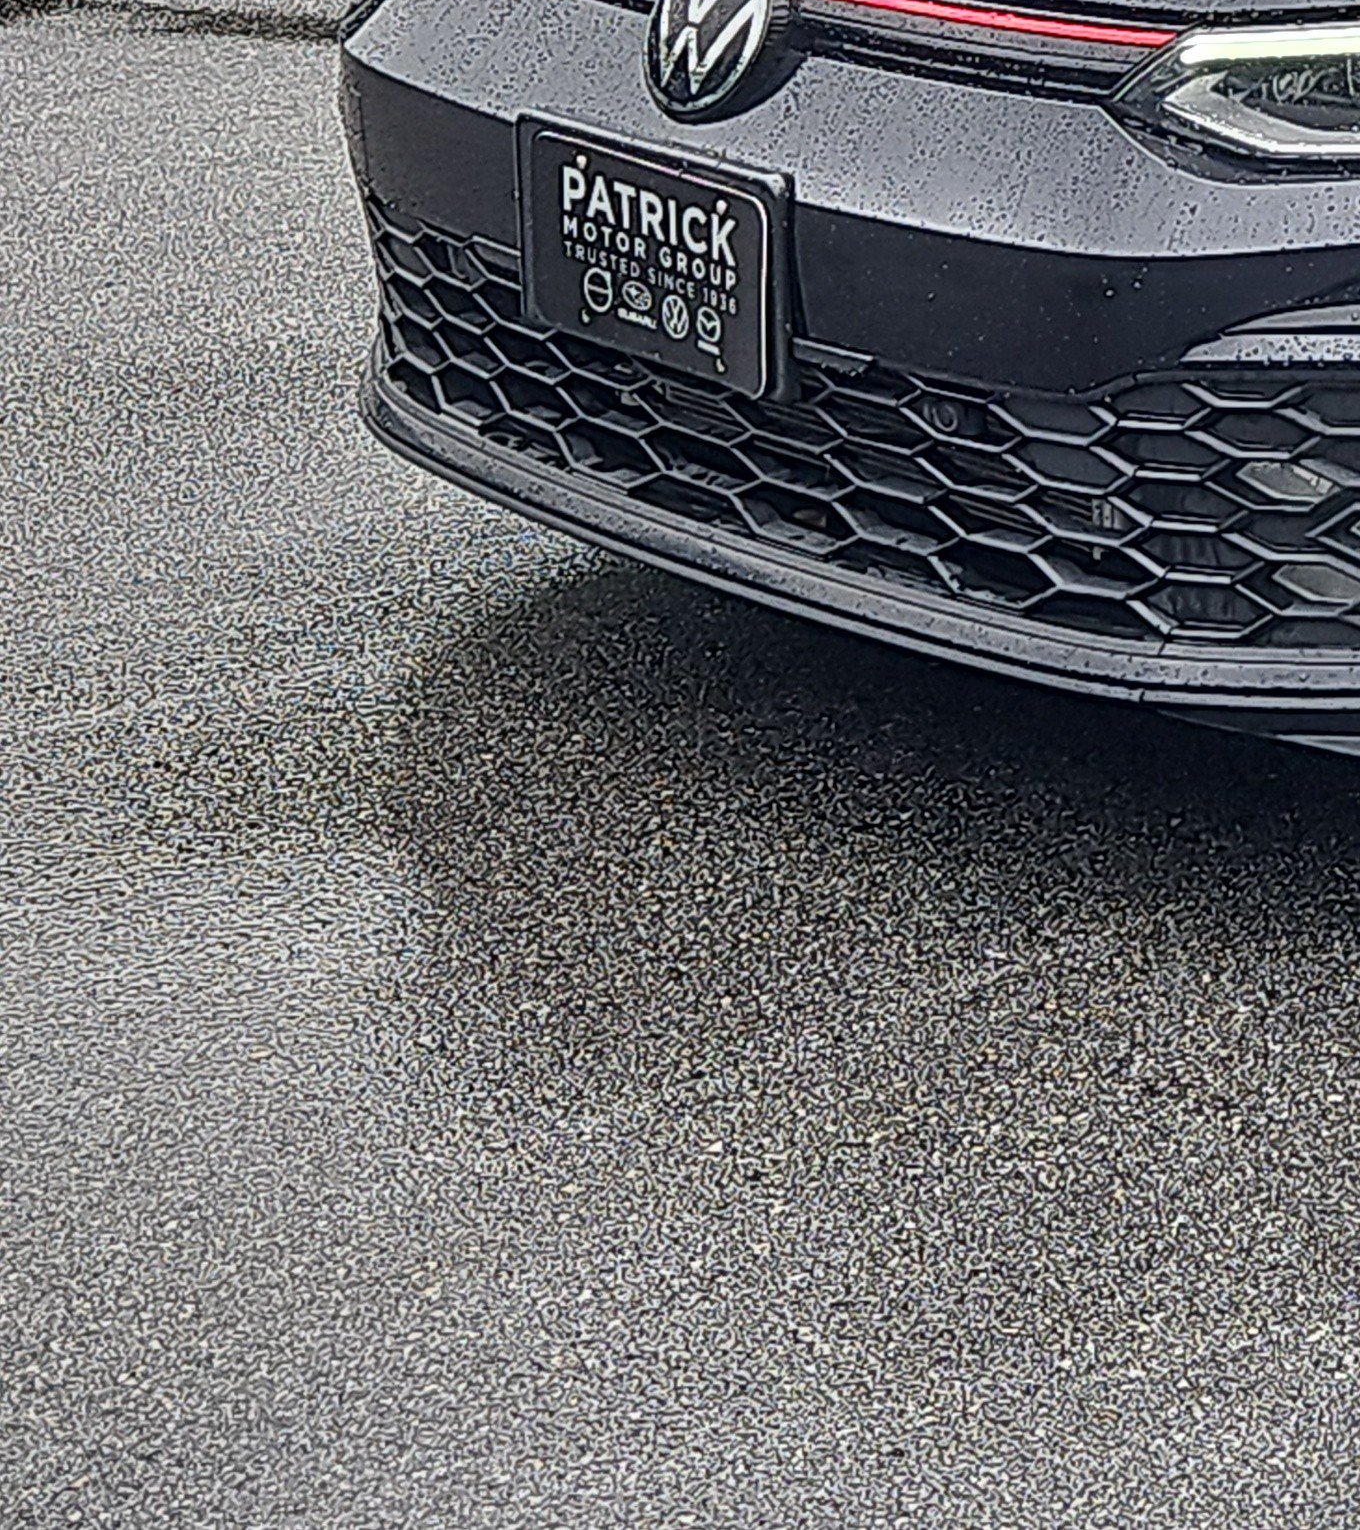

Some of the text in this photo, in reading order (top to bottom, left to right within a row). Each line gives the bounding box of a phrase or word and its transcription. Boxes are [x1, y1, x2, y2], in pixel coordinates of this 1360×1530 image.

[562, 164, 737, 267] PATRICK
[563, 214, 737, 291] MOTOR GROUP
[564, 240, 737, 315] TRUSTED SINCE 1936
